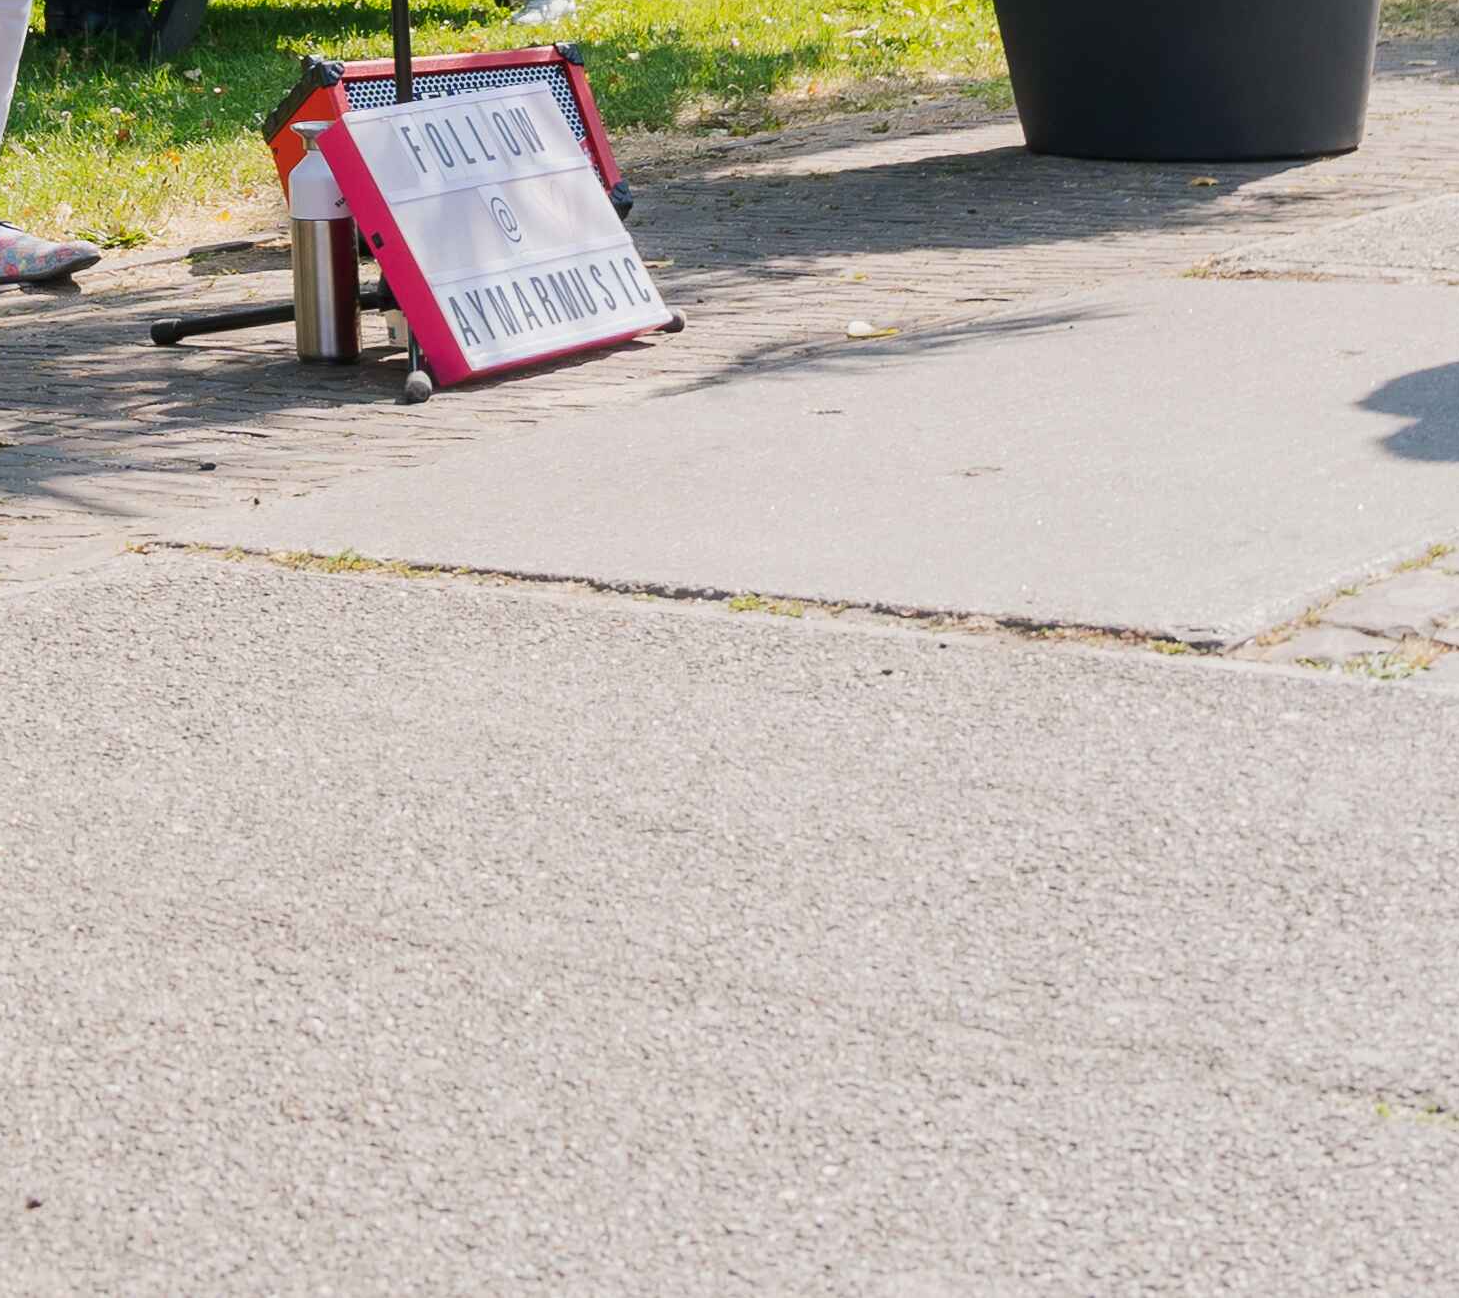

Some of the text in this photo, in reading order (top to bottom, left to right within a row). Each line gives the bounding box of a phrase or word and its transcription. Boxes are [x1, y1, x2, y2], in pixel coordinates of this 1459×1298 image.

[399, 106, 546, 174] FOLLOW
[490, 196, 523, 244] @
[446, 256, 653, 347] AYMARMUSIC
